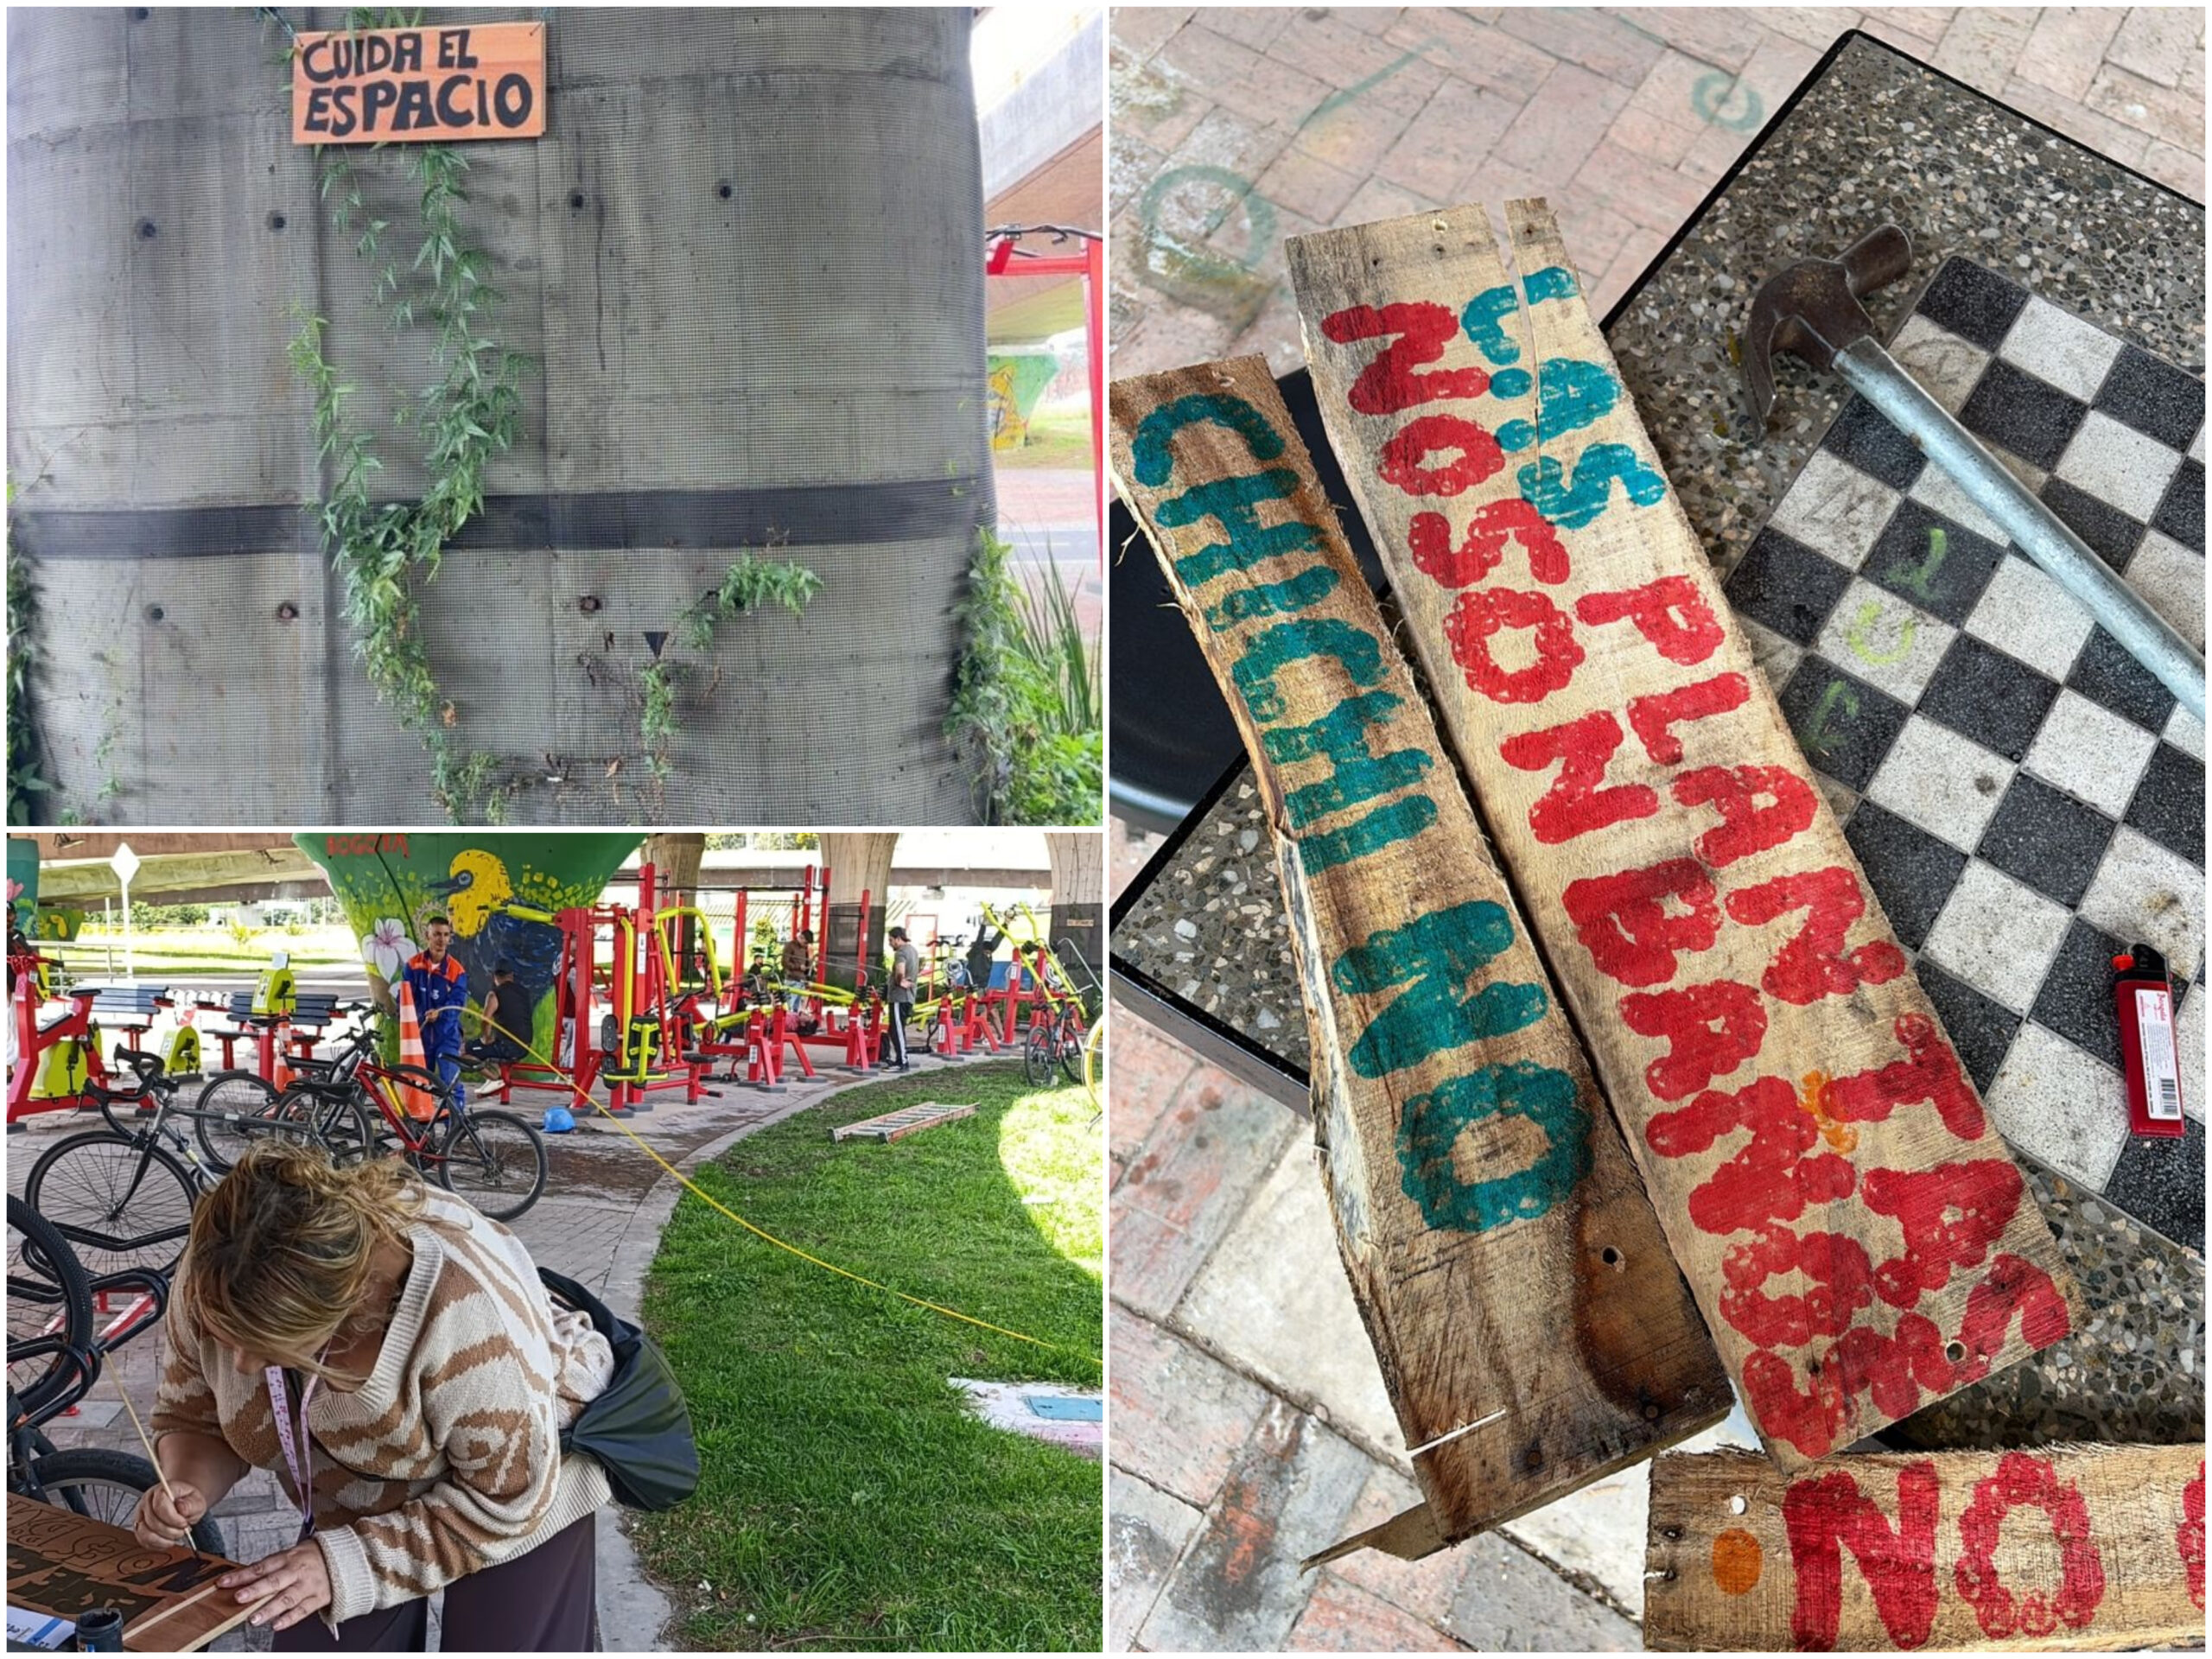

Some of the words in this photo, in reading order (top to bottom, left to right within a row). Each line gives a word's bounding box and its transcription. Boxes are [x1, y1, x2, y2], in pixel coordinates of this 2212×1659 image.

[302, 33, 422, 83] CUIDA
[438, 29, 478, 69] EL
[303, 73, 533, 137] ESPACIO
[1132, 393, 1438, 876] CHICHI
[1332, 899, 1594, 1232] NO
[1460, 266, 1666, 529] LAS
[1577, 574, 2070, 1395] PLANTAS
[1782, 1451, 2106, 1652] NO
